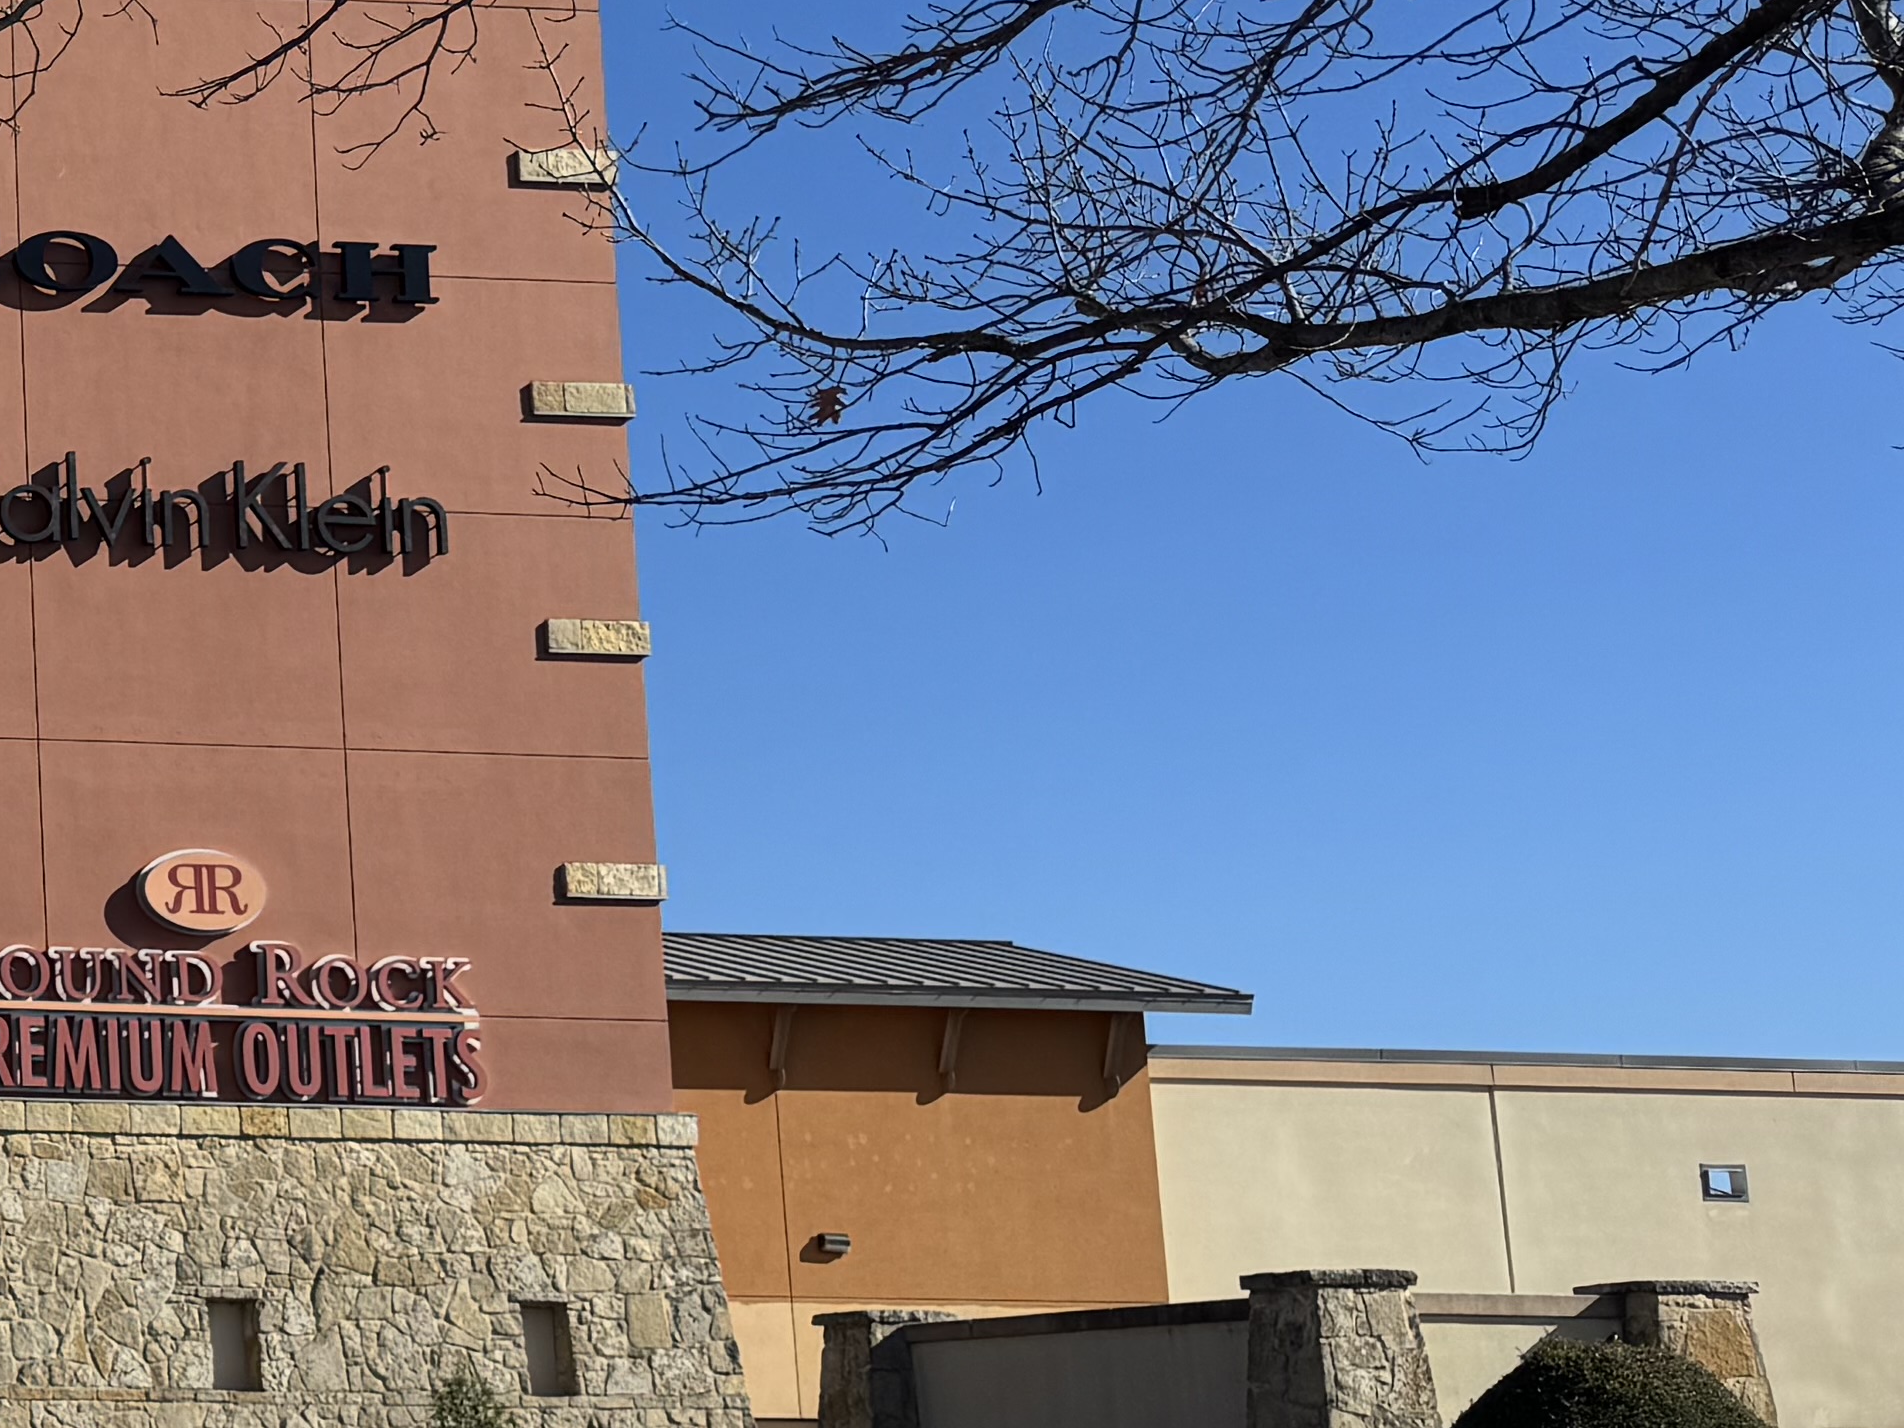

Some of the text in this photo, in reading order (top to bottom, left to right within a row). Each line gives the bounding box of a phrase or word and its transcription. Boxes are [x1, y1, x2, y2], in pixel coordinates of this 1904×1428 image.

[233, 460, 449, 556] Klein
[250, 939, 474, 1012] ROCK
[236, 1021, 490, 1106] OUTLETS
